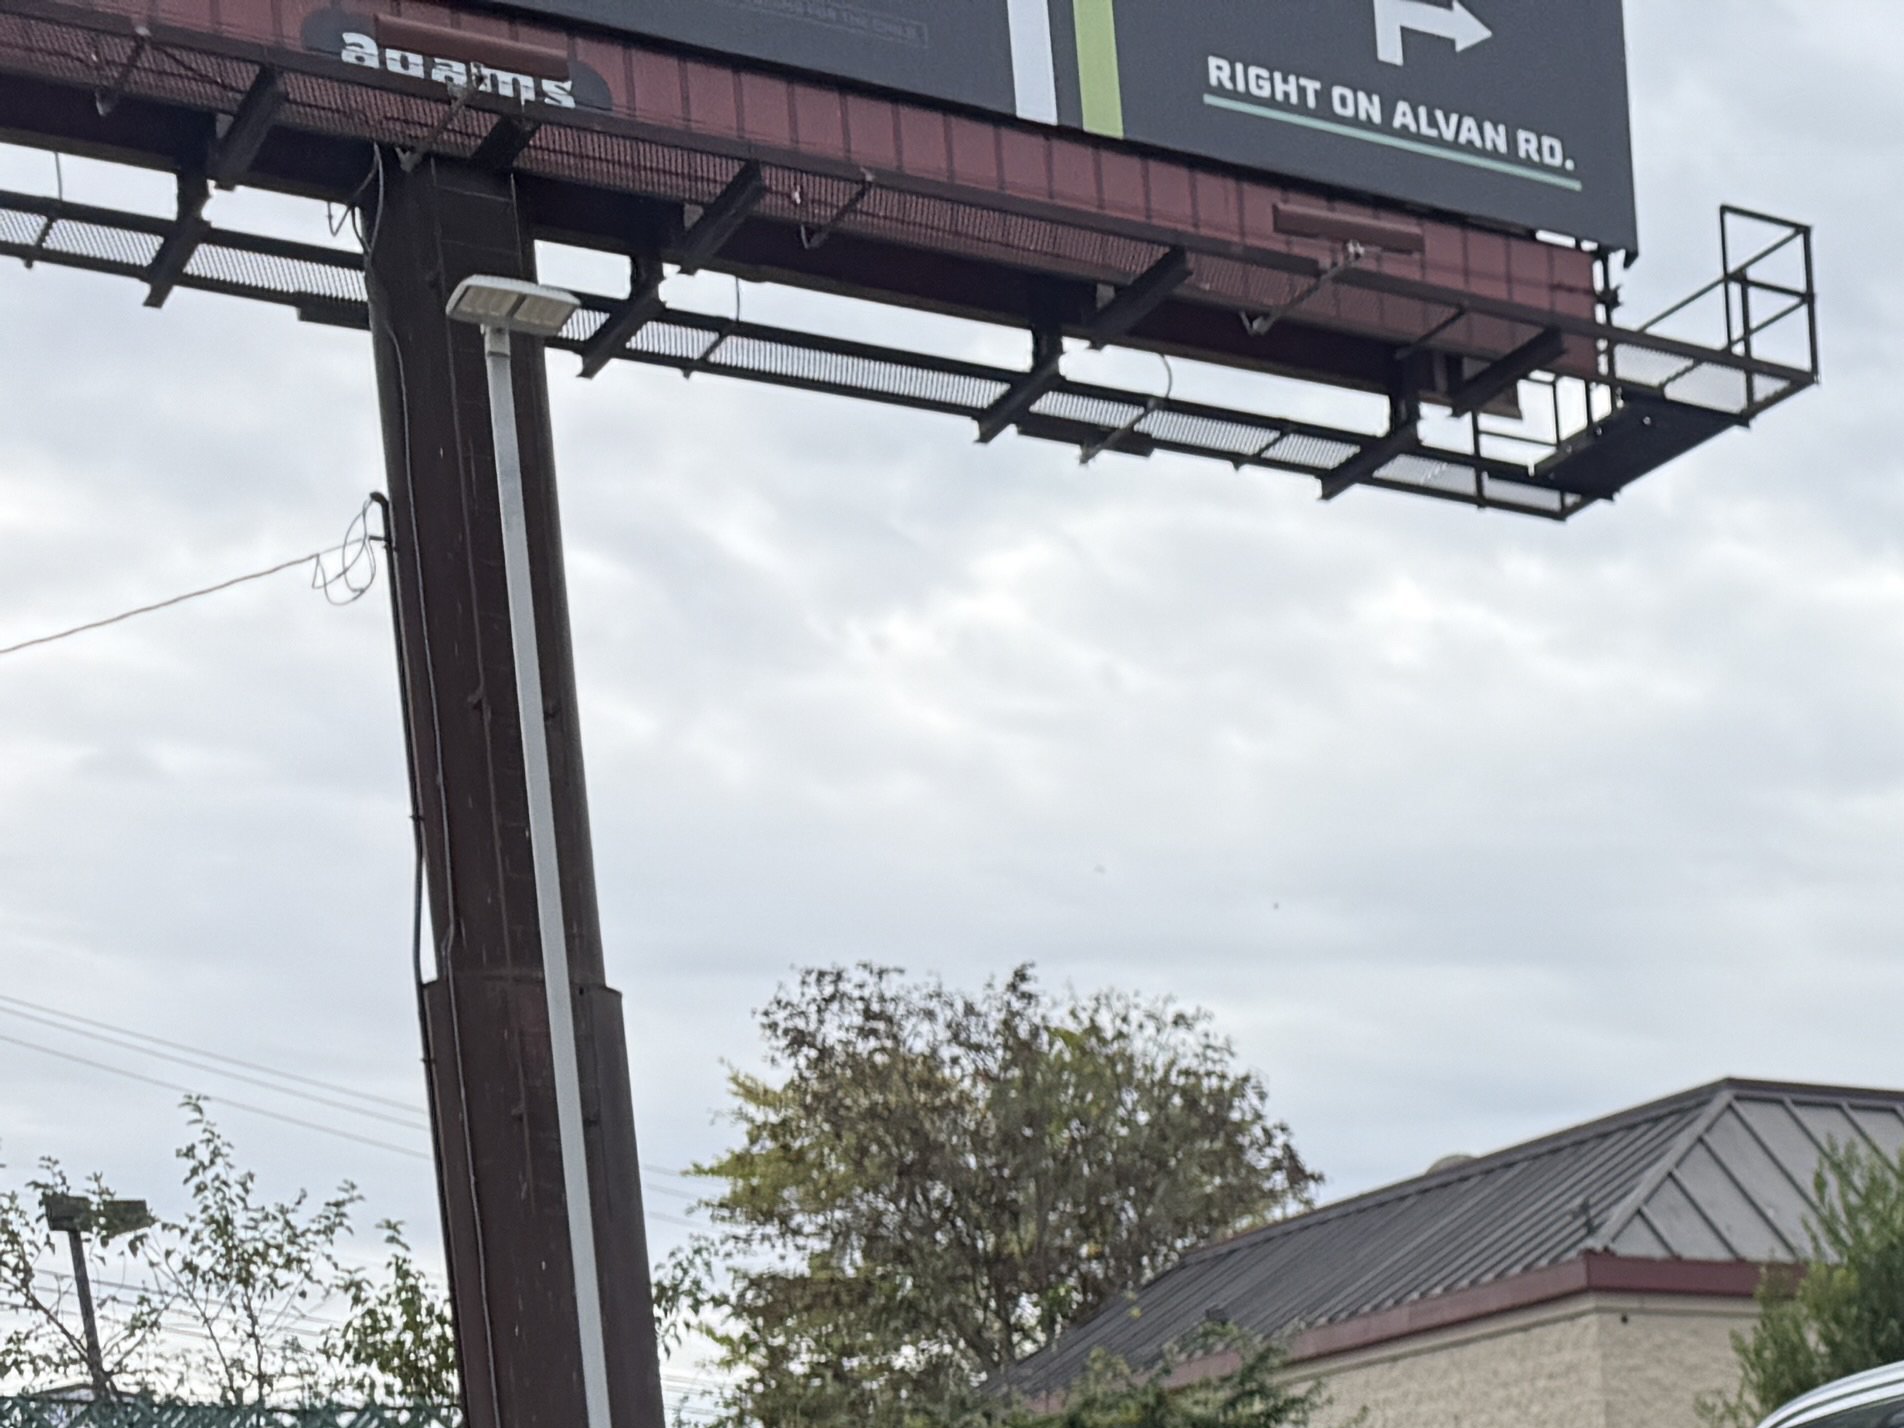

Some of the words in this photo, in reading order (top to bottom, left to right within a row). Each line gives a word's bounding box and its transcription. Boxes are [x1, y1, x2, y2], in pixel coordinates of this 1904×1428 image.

[1207, 55, 1321, 110] RIGHT
[1331, 84, 1382, 125] ON
[1392, 99, 1508, 155] ALVAN
[1517, 128, 1576, 171] RD.
